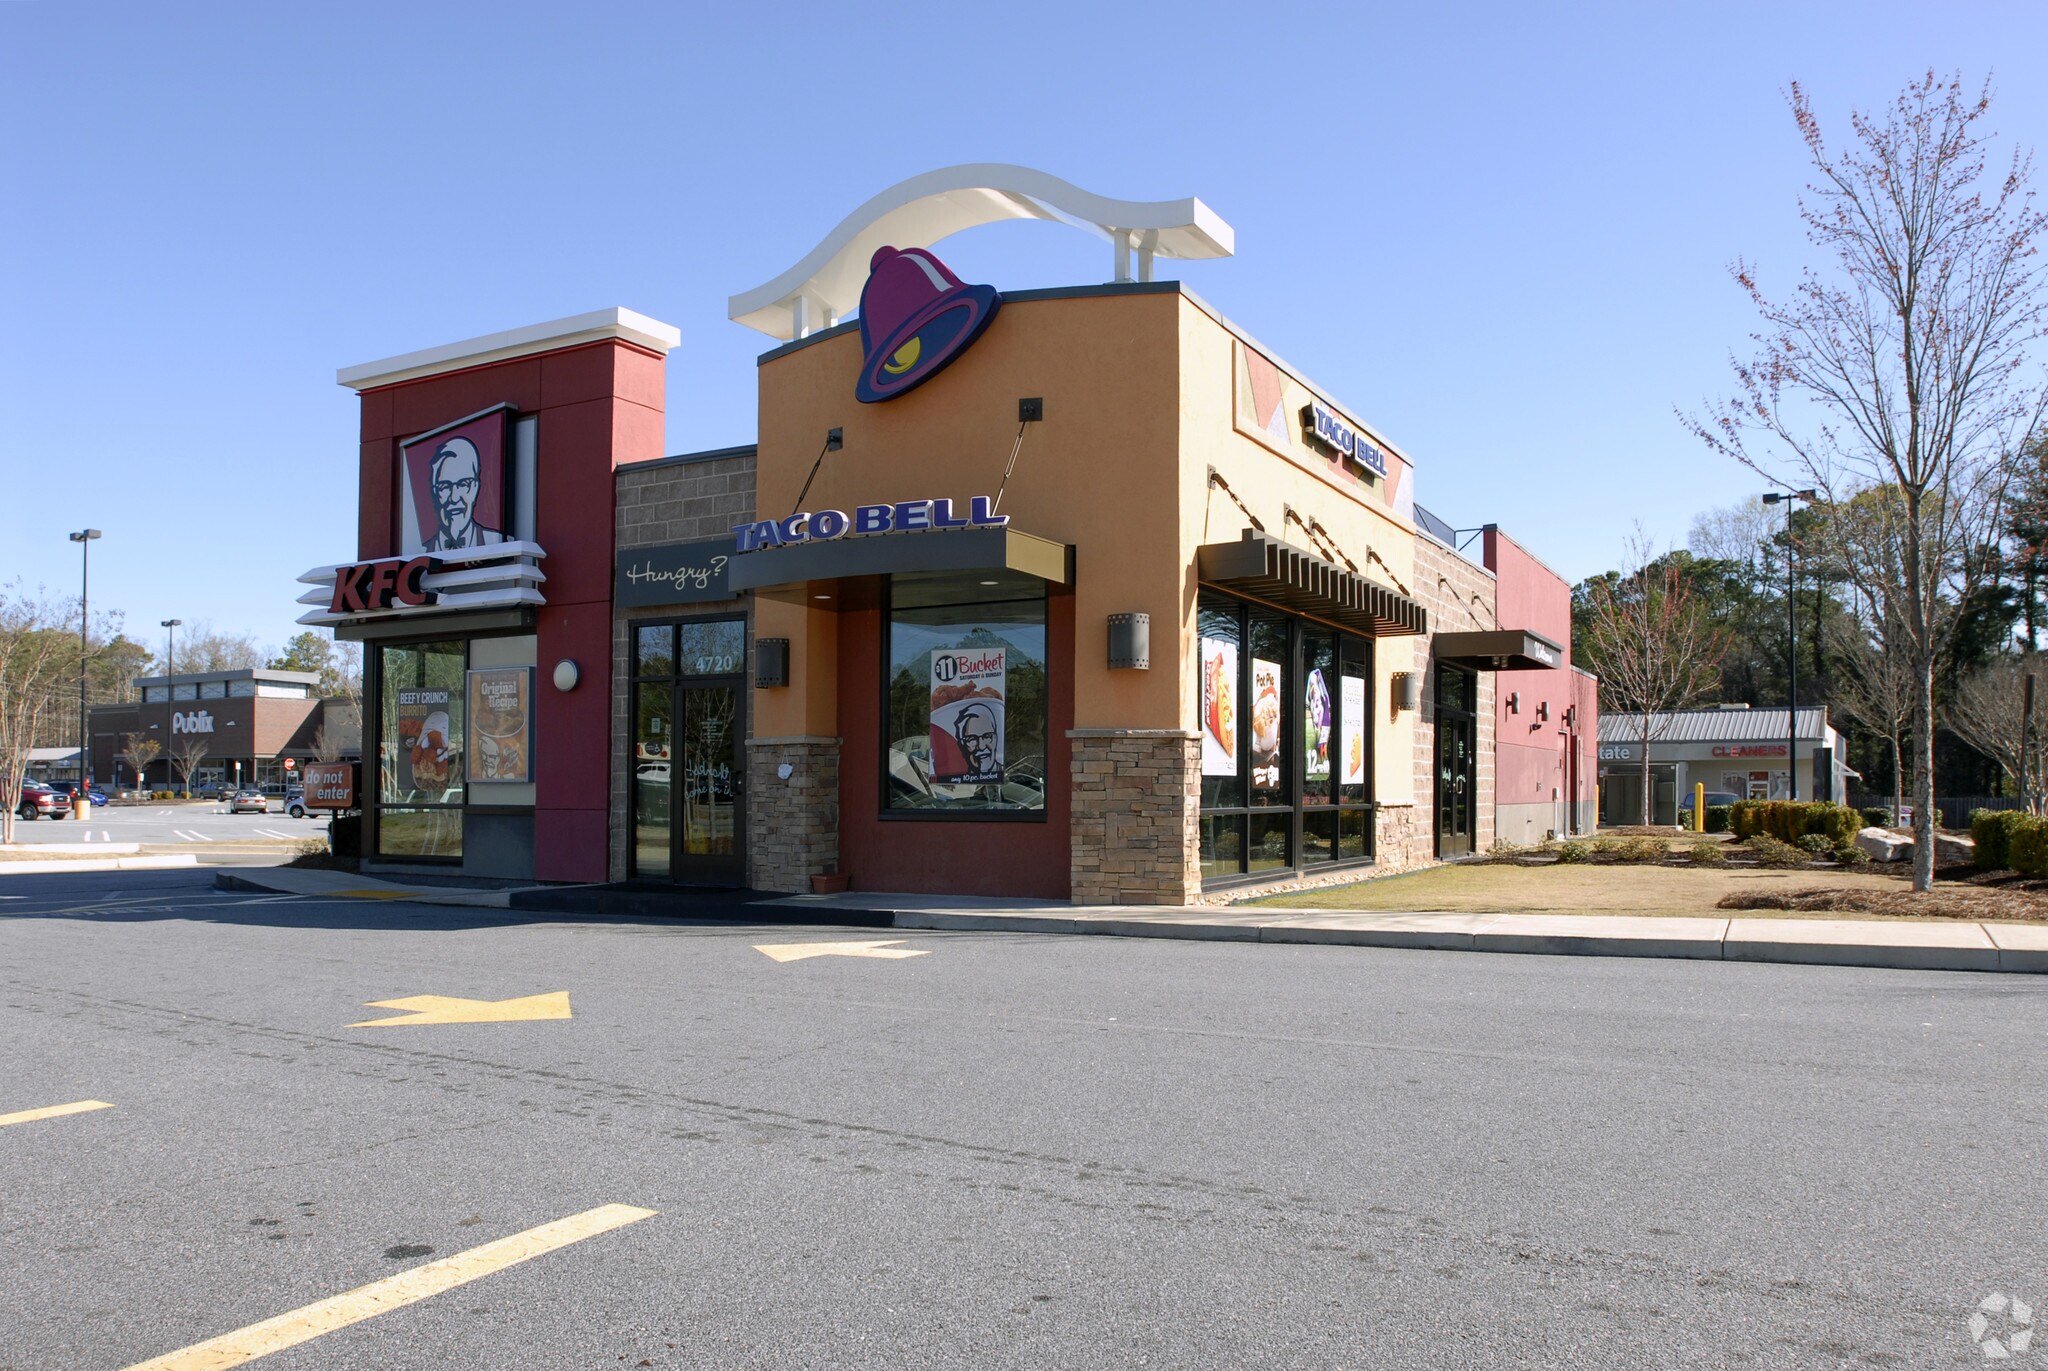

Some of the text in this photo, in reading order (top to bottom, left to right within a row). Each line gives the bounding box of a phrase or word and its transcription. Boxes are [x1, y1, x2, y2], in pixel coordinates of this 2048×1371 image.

[1315, 406, 1388, 477] TACO BELL
[732, 496, 1010, 552] TACO BELL
[626, 555, 728, 591] Hungry?
[327, 556, 443, 613] KFC
[695, 655, 733, 673] 4720
[935, 652, 1005, 681] $11 Bucket
[400, 691, 448, 704] BEEFY CRUNCH
[481, 681, 517, 698] Original
[488, 694, 518, 709] Recipe
[400, 705, 428, 716] BURRITO
[173, 710, 214, 734] Publix
[1711, 745, 1788, 757] CLEANERS
[305, 769, 343, 784] do not
[316, 786, 350, 800] enter
